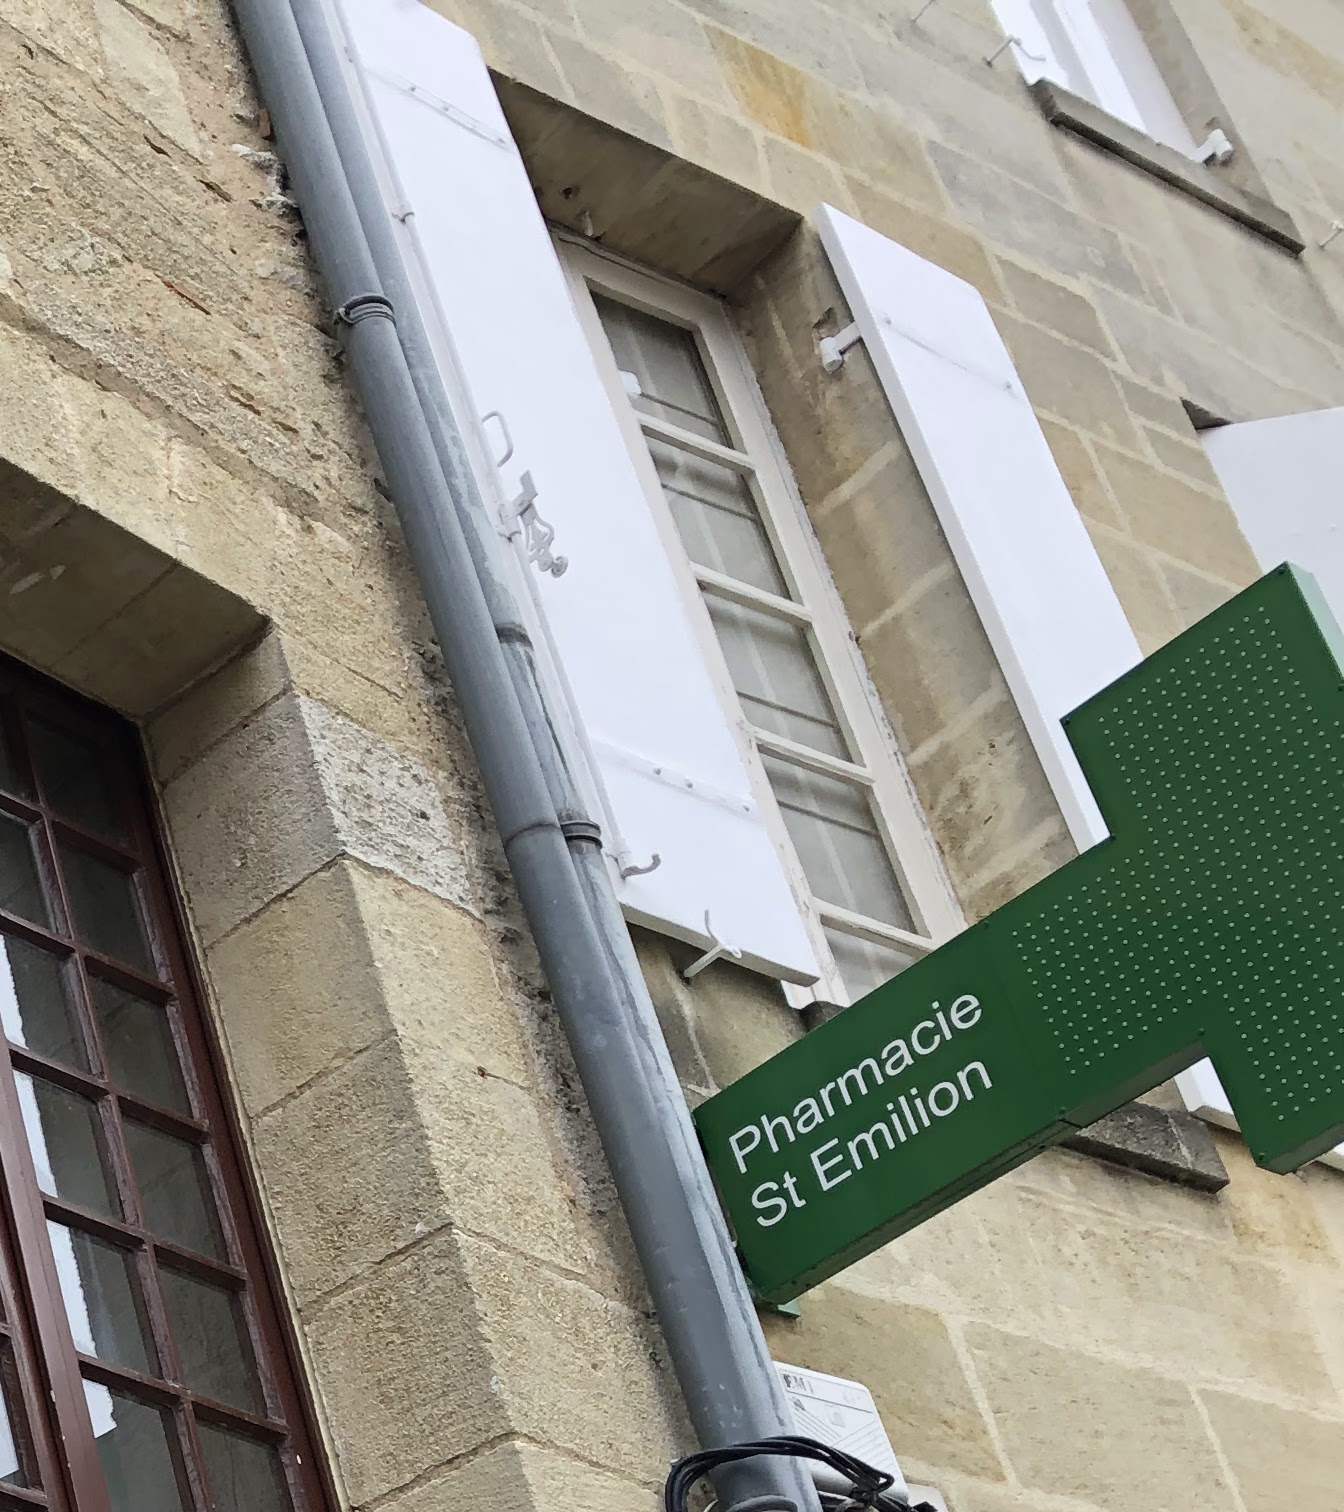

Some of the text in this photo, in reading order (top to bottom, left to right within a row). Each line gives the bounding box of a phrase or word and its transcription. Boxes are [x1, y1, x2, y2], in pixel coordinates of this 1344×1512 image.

[728, 993, 983, 1175] Pharmacie
[751, 1060, 993, 1228] St Emilion
